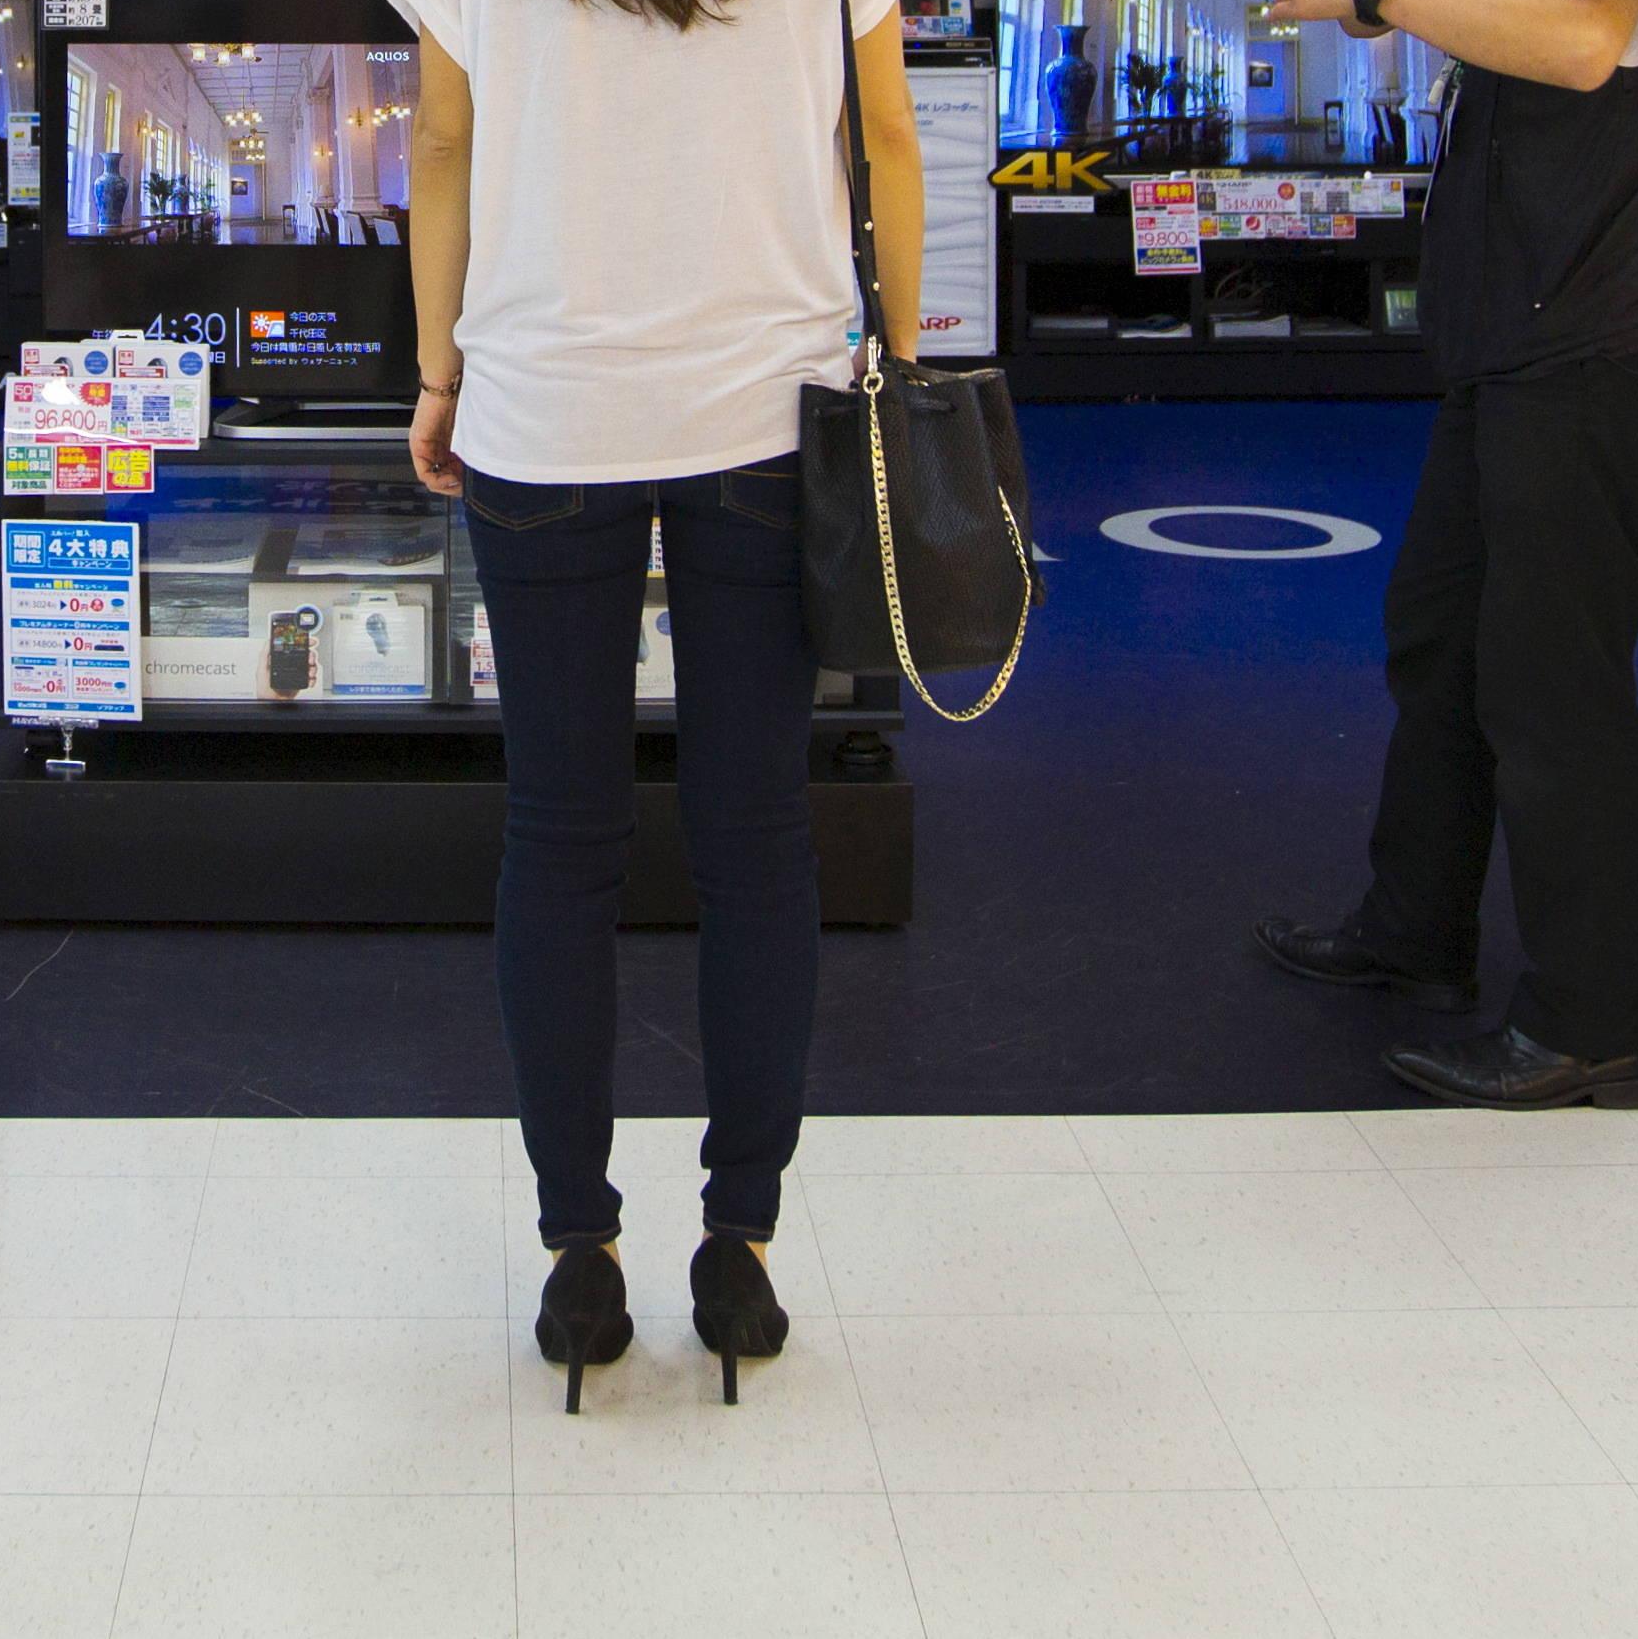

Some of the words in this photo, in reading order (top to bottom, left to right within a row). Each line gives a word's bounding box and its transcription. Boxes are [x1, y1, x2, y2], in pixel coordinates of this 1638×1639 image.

[991, 151, 1114, 190] 4K
[289, 311, 336, 323] 今日の天気
[145, 312, 226, 345] 4:30
[48, 539, 130, 558] 4大特典
[144, 660, 237, 676] chromecast
